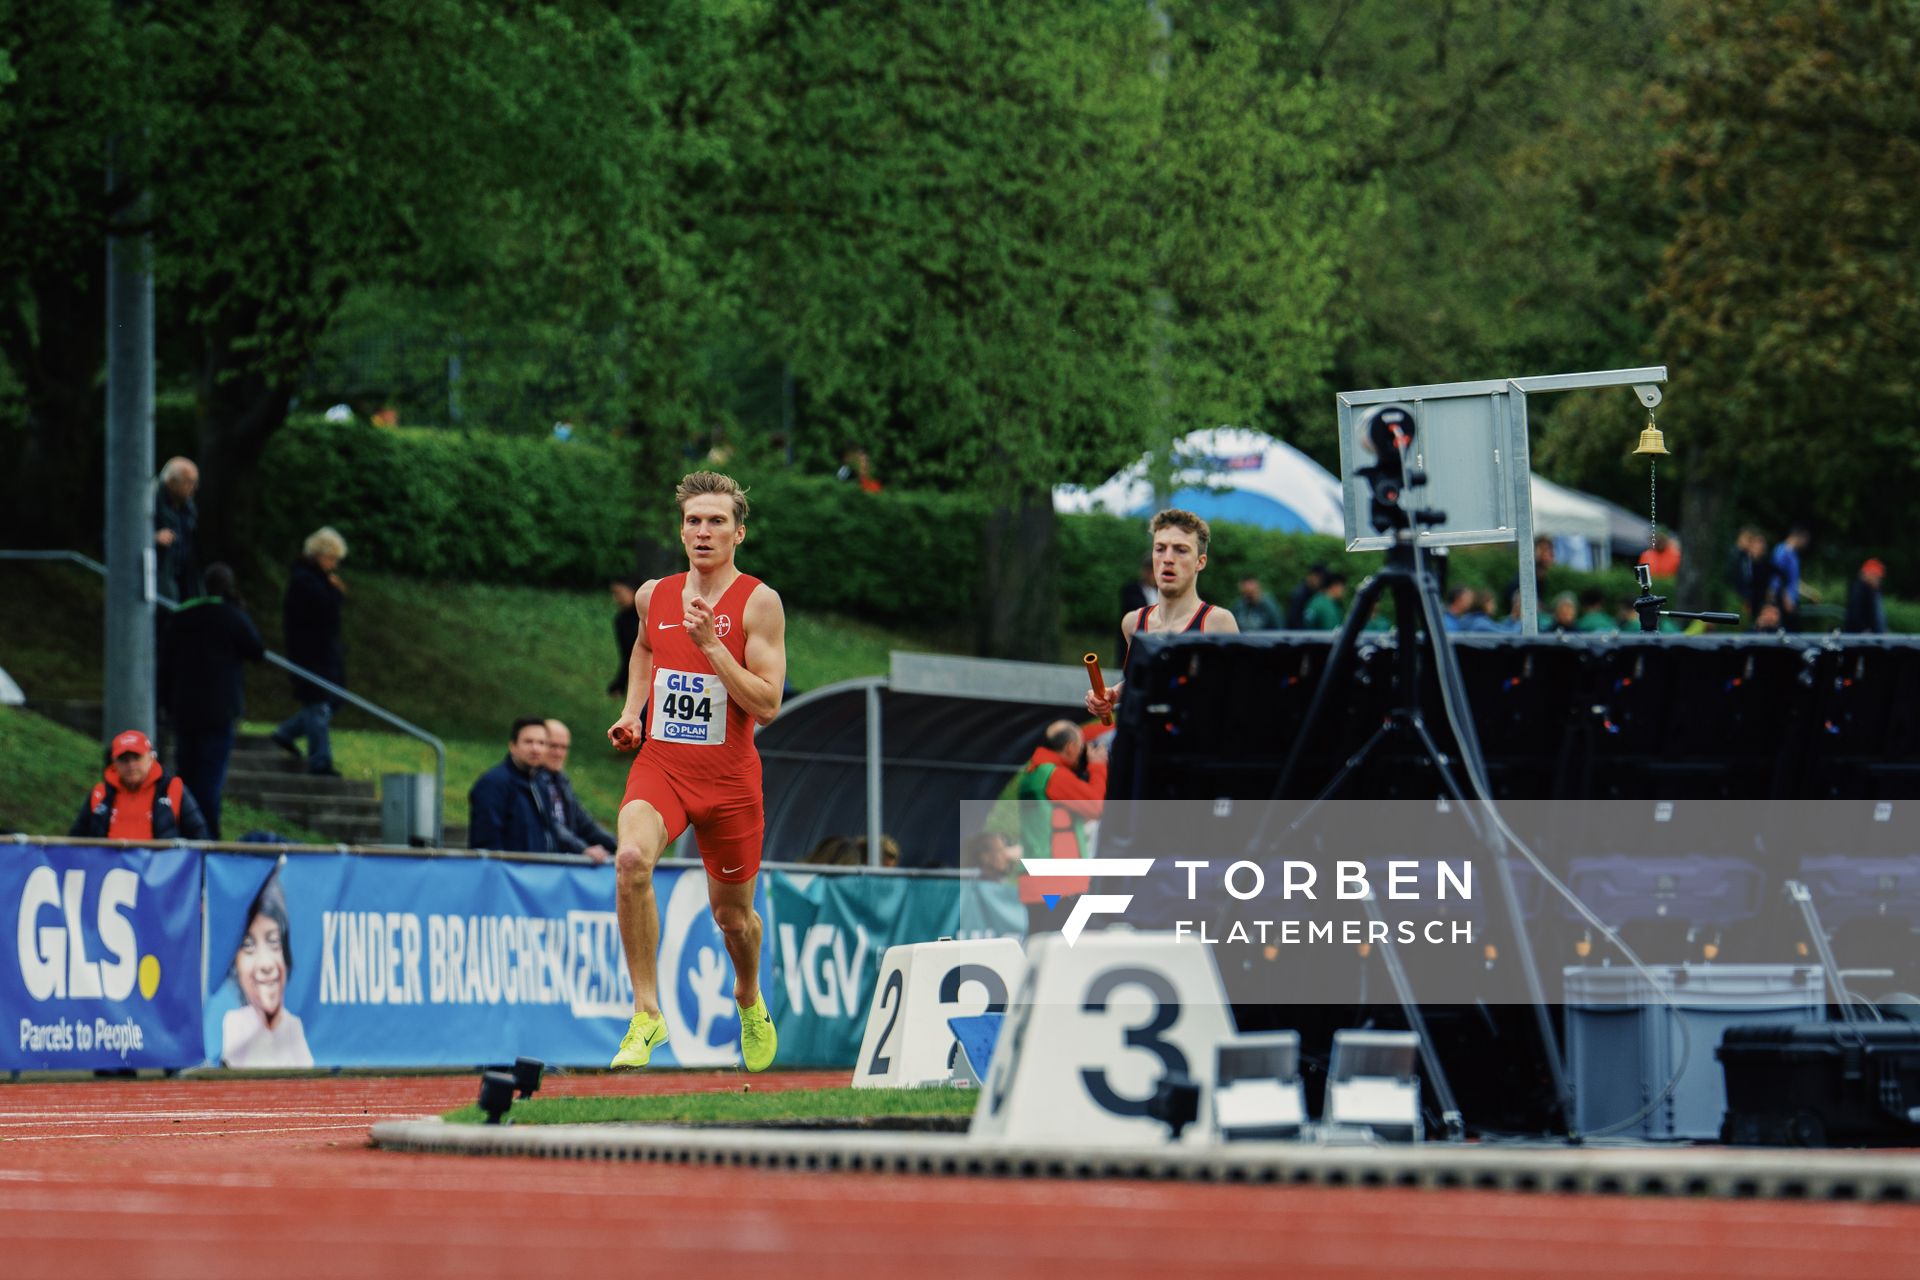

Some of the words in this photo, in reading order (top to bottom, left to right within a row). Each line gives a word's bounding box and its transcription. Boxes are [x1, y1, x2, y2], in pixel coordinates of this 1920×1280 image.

[663, 693, 712, 722] 494
[681, 726, 706, 735] PLAN
[320, 911, 424, 1005] KINDER
[20, 1016, 74, 1052] Parcels
[75, 1018, 93, 1052] to
[95, 1015, 144, 1060] People
[868, 968, 904, 1076] 2
[1079, 965, 1190, 1118] 3
